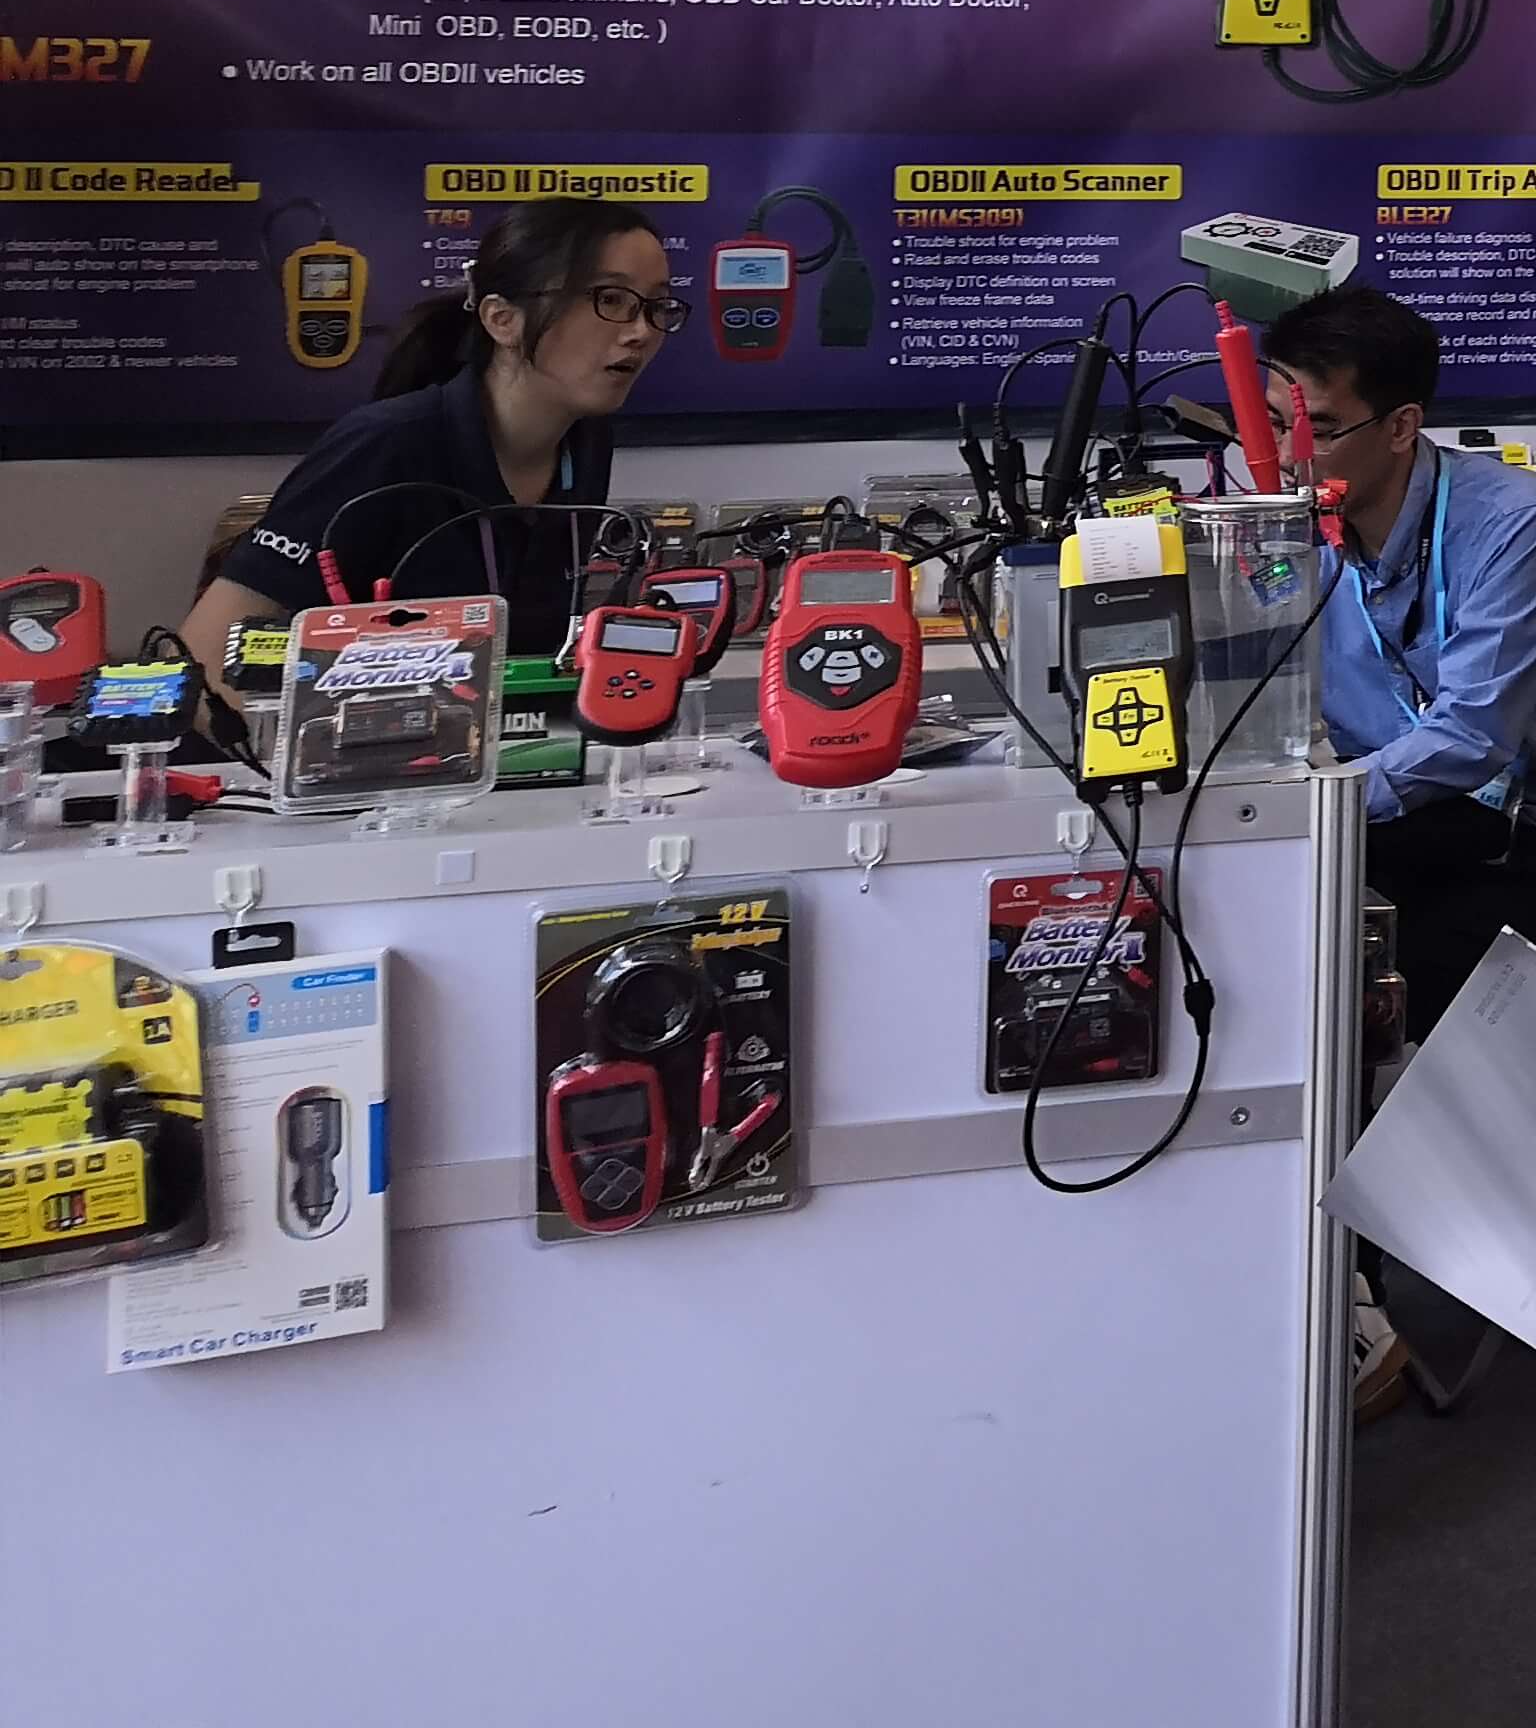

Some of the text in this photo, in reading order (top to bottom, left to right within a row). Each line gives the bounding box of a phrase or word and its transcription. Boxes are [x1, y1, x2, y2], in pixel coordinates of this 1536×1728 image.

[247, 60, 584, 84] Work on all OBDII vehicles
[51, 168, 128, 192] Code
[136, 168, 240, 193] Reader
[443, 169, 694, 199] OBD II Diagnostic
[911, 169, 1170, 193] OBDII Auto Scanner
[1388, 170, 1440, 191] OBD
[1448, 169, 1460, 191] II
[1467, 169, 1515, 196] Trip
[1377, 205, 1452, 225] BLE327
[905, 253, 1099, 265] Read and erase trouble codes
[1387, 250, 1433, 262] Trouble
[1436, 249, 1504, 263] description,
[1508, 248, 1536, 260] DTC
[824, 629, 864, 641] BK1
[121, 1320, 320, 1365] Smart Car Charger
